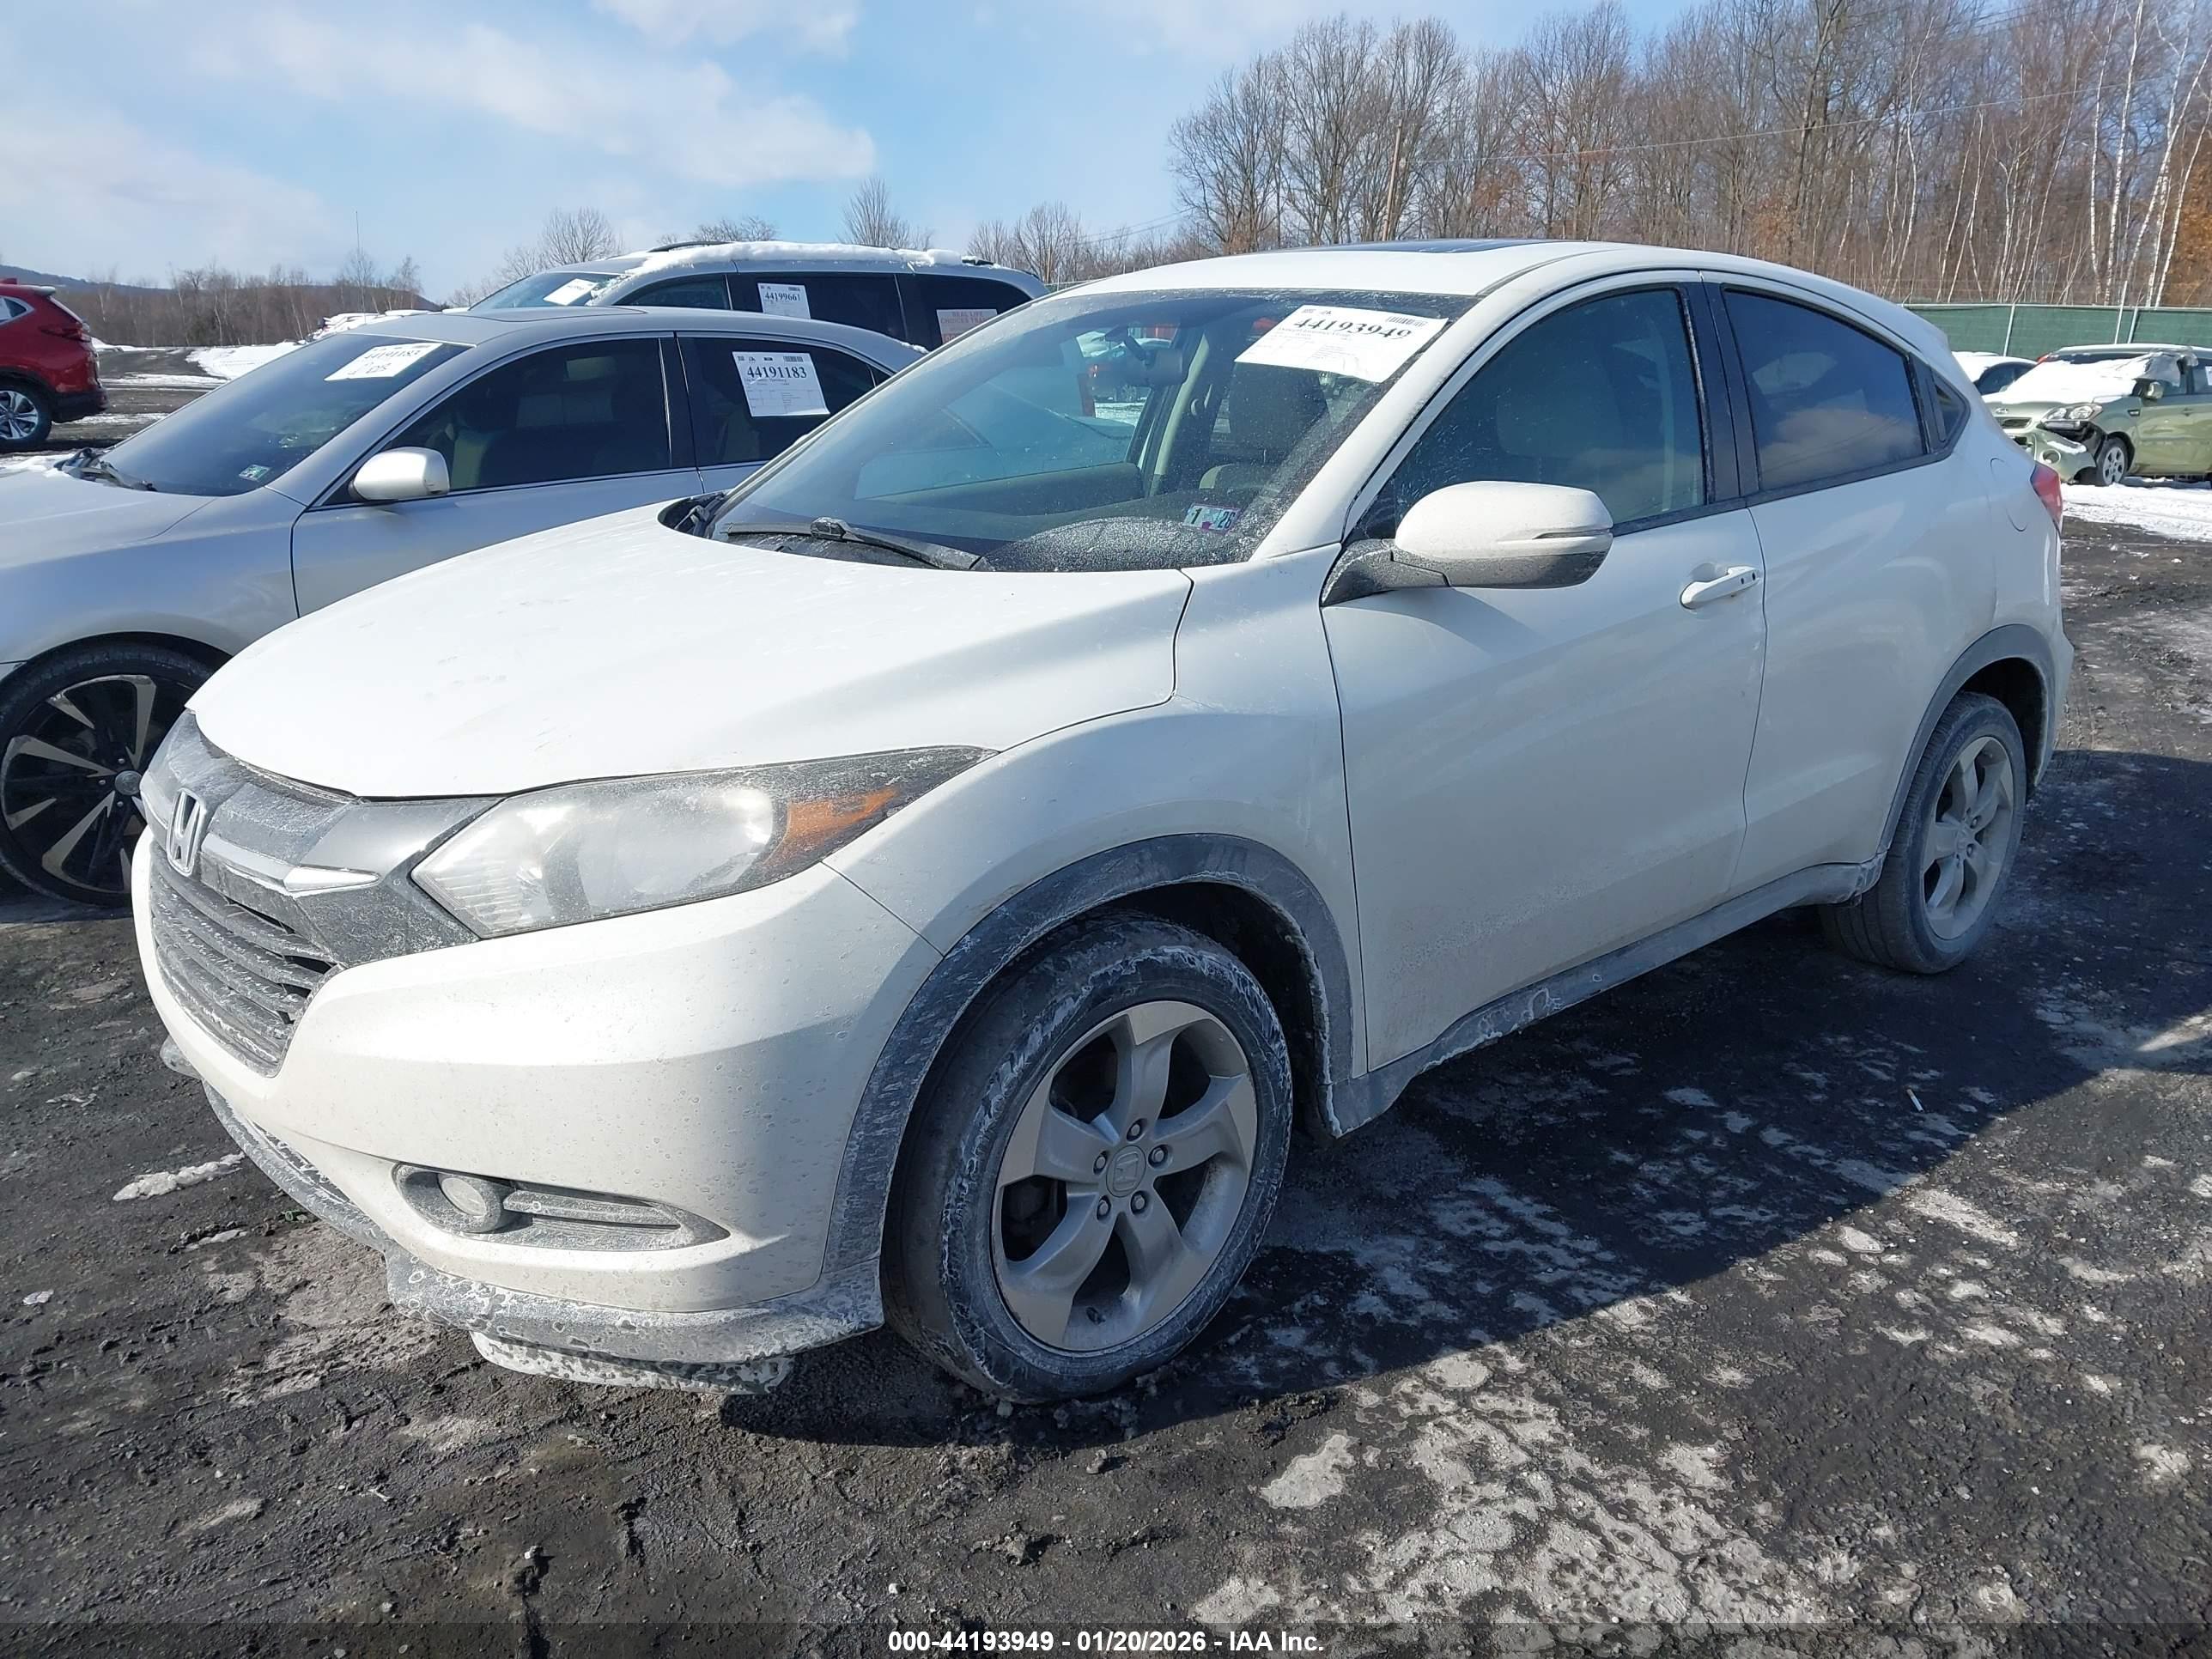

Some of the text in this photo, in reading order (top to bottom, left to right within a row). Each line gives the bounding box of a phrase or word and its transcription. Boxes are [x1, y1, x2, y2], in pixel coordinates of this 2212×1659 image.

[764, 292, 800, 301] 44199661
[1293, 318, 1412, 339] 44193949
[747, 366, 807, 379] 44191183
